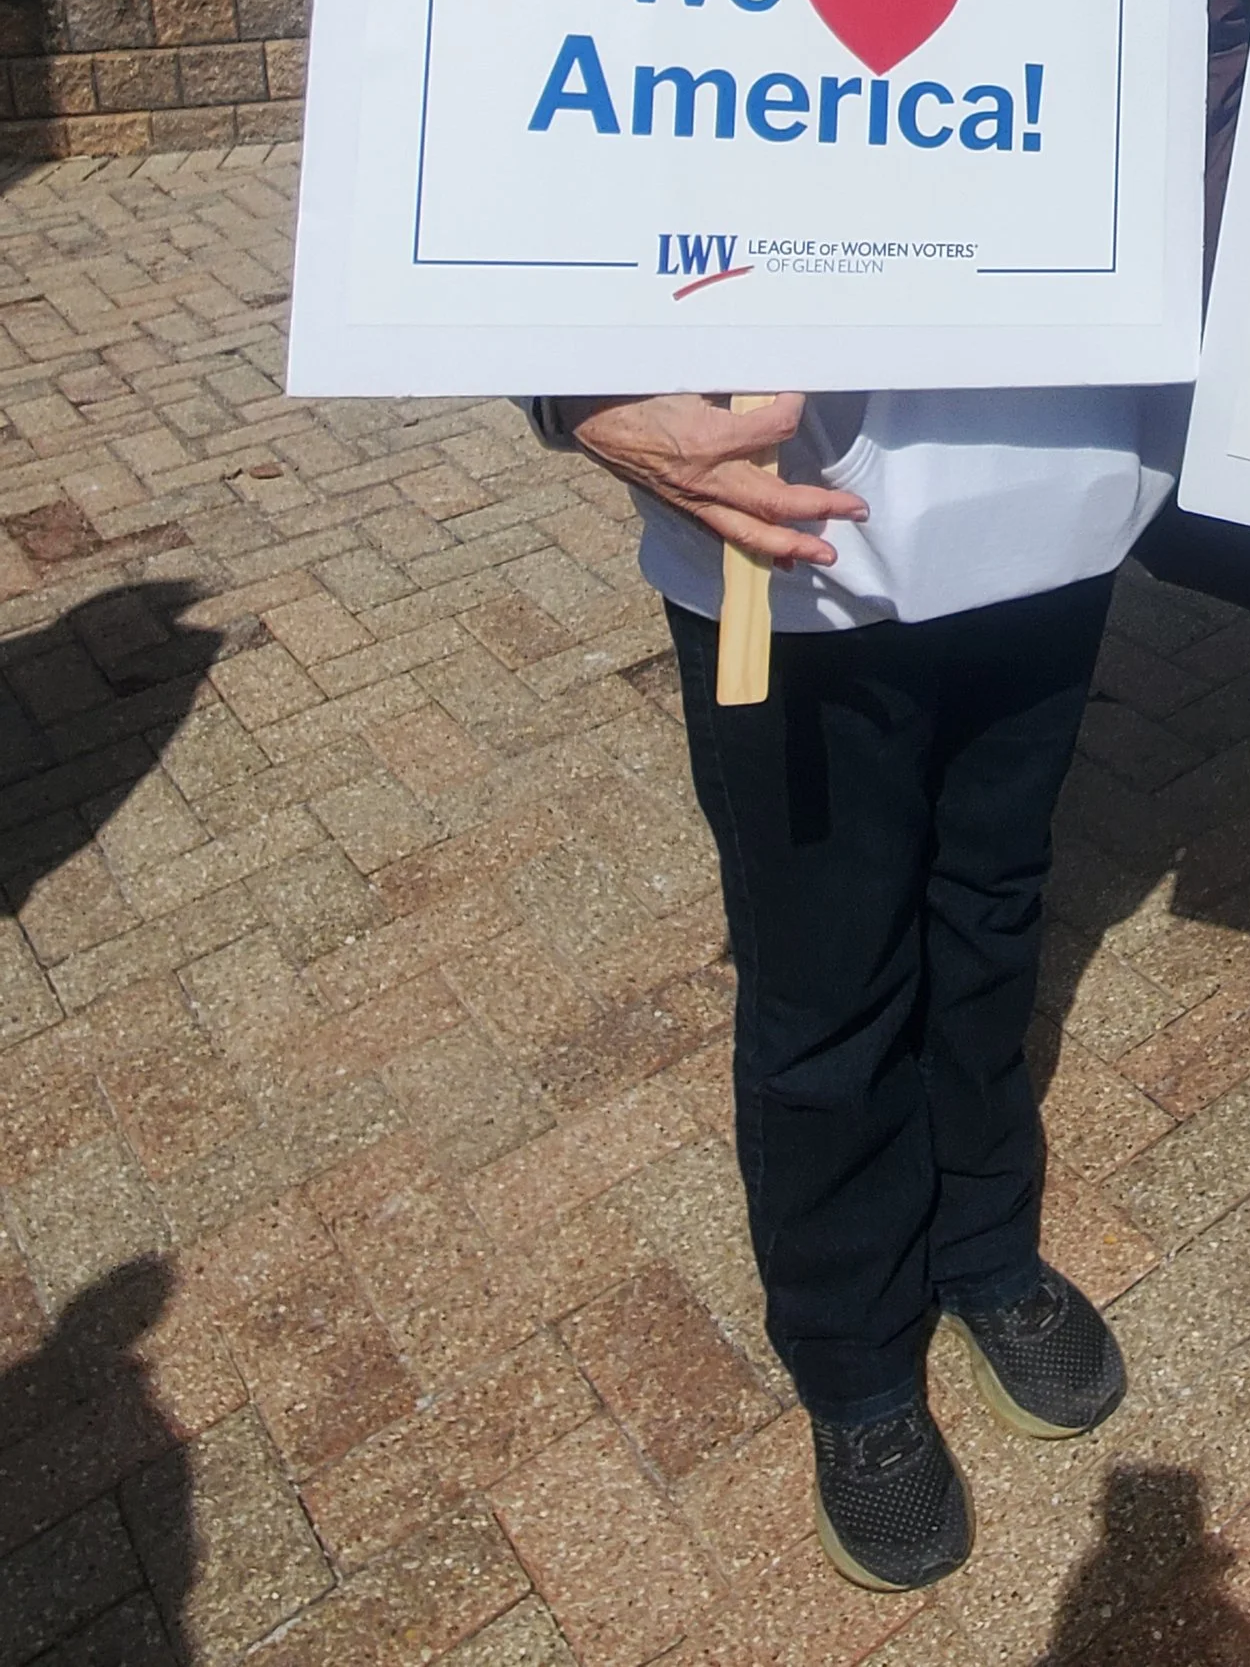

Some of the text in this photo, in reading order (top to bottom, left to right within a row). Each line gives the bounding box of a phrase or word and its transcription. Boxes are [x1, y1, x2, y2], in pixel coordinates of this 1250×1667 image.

[527, 34, 1045, 152] America!
[655, 234, 739, 275] LWV
[748, 239, 816, 256] LEAGUE
[841, 241, 909, 258] WOMEN
[913, 242, 976, 259] VOTERS
[766, 257, 884, 275] OF GLEN ELLYN
